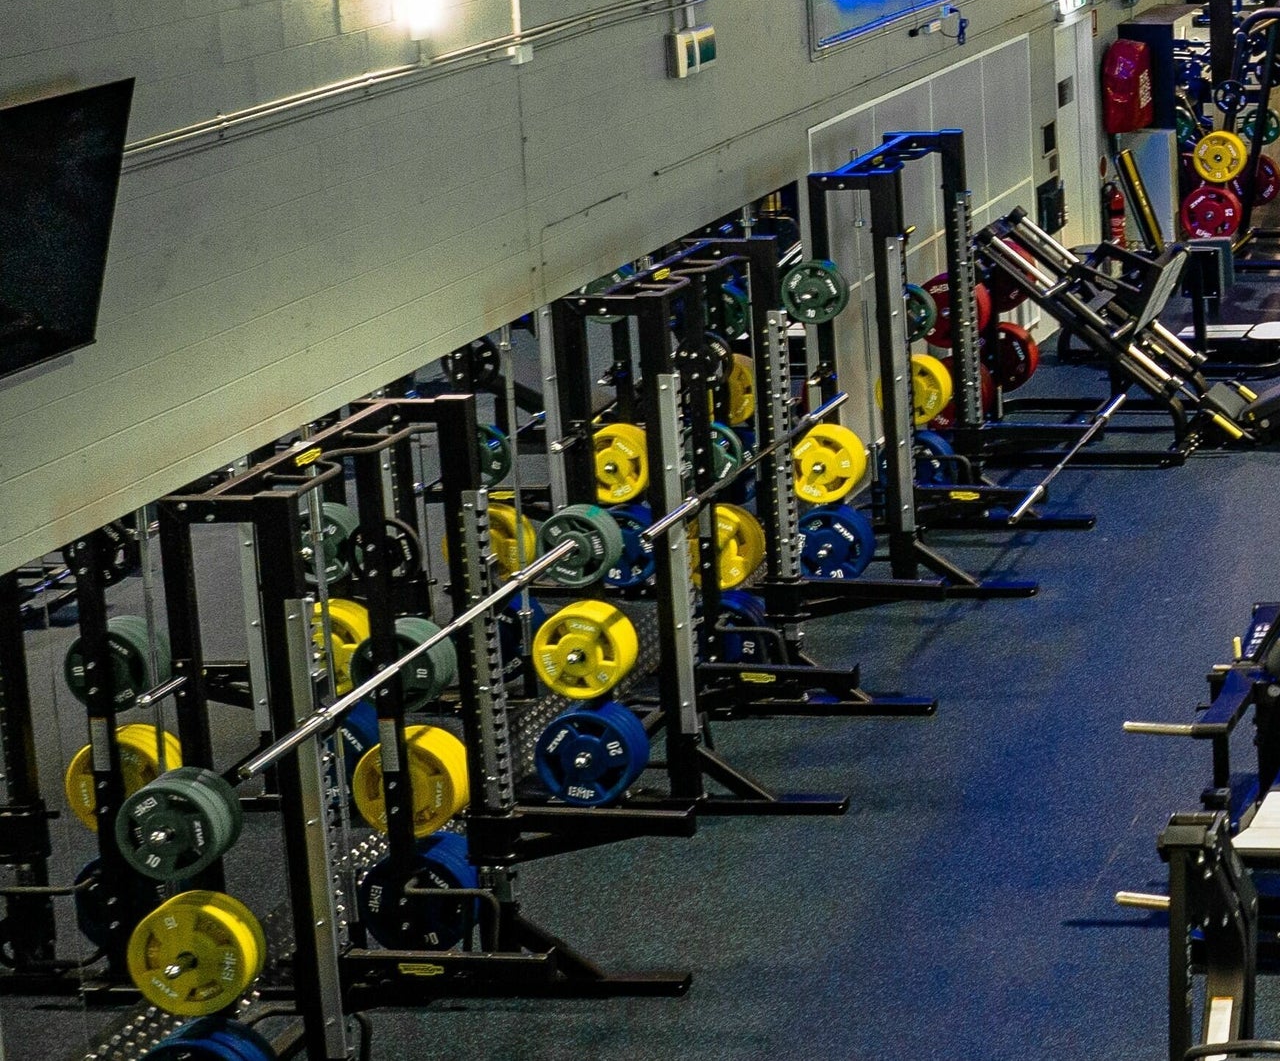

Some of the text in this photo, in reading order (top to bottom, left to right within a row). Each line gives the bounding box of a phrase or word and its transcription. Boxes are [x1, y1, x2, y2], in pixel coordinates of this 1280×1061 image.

[605, 740, 624, 758] 20
[567, 786, 595, 800] EMF
[145, 853, 161, 868] 10
[222, 952, 237, 982] EMF
